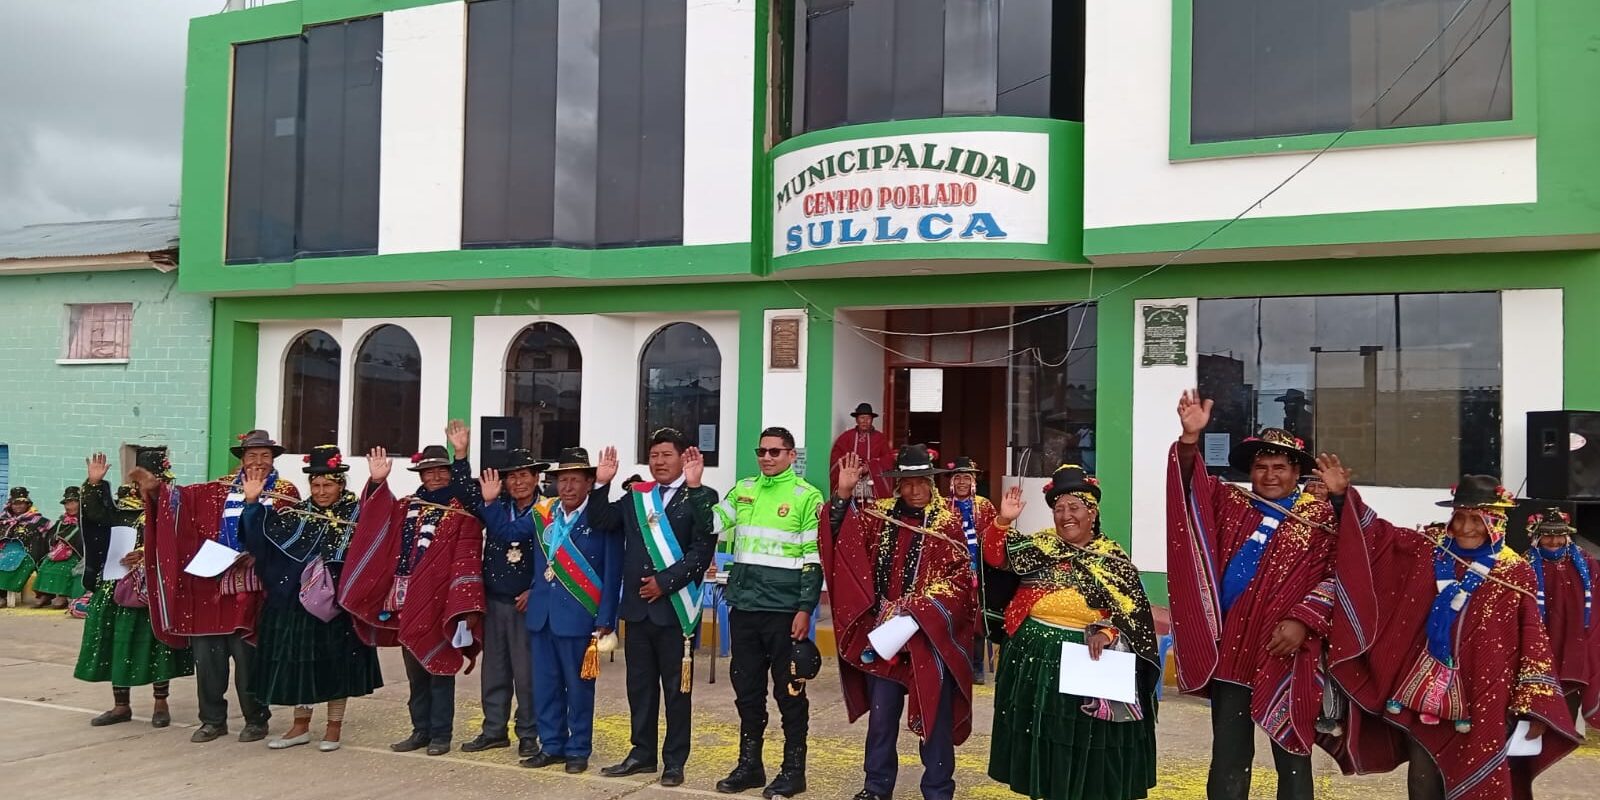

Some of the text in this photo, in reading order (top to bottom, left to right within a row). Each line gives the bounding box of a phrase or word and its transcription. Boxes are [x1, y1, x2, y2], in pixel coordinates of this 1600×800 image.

[776, 143, 1036, 211] MUNICIPALIDAD
[803, 182, 977, 216] CENTRO POBLADO
[786, 212, 1007, 252] SULLCA
